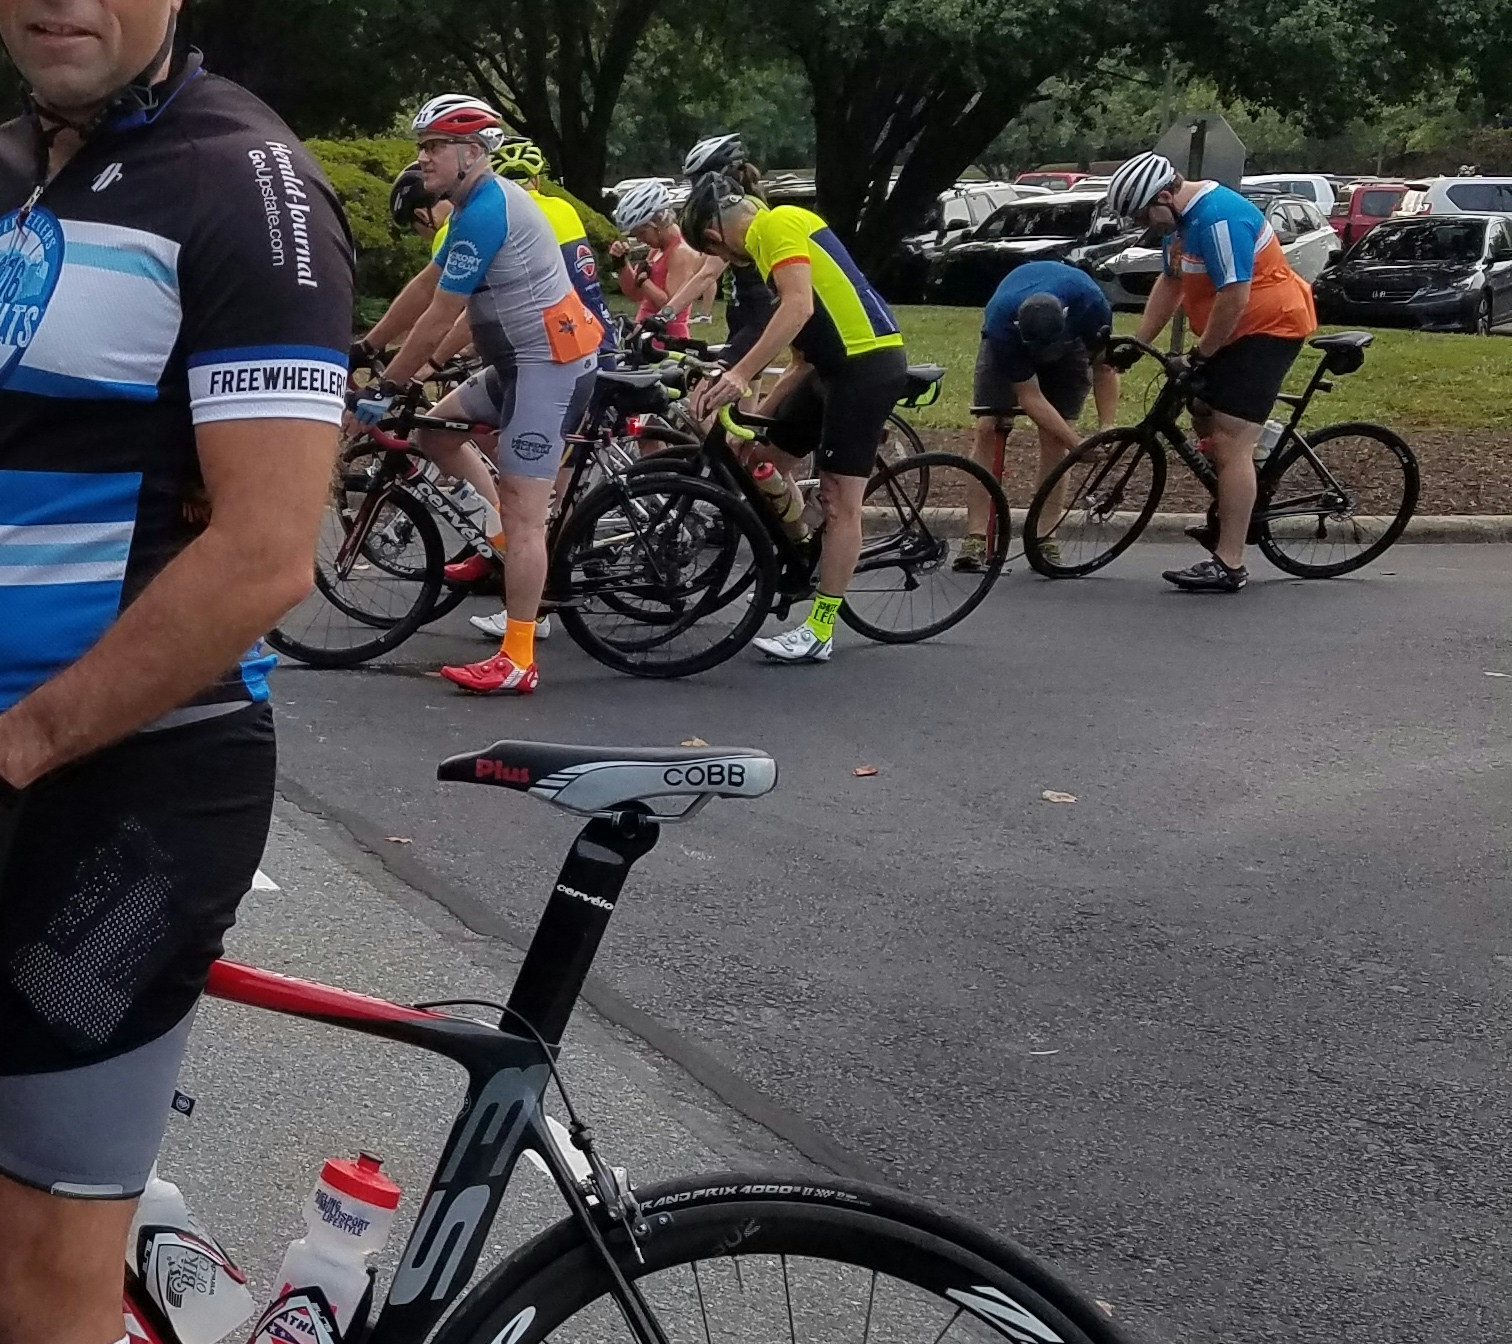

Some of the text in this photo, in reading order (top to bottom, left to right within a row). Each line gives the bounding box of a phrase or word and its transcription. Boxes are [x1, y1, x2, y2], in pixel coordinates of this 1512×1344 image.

[248, 149, 285, 267] GoUpstate.com
[265, 141, 318, 288] Herald-Journal
[416, 482, 493, 559] cervélo
[475, 758, 529, 784] Plus
[663, 763, 746, 788] COBB
[556, 883, 615, 911] cervélo
[637, 1192, 692, 1211] RAND
[692, 1185, 739, 1201] PRIX
